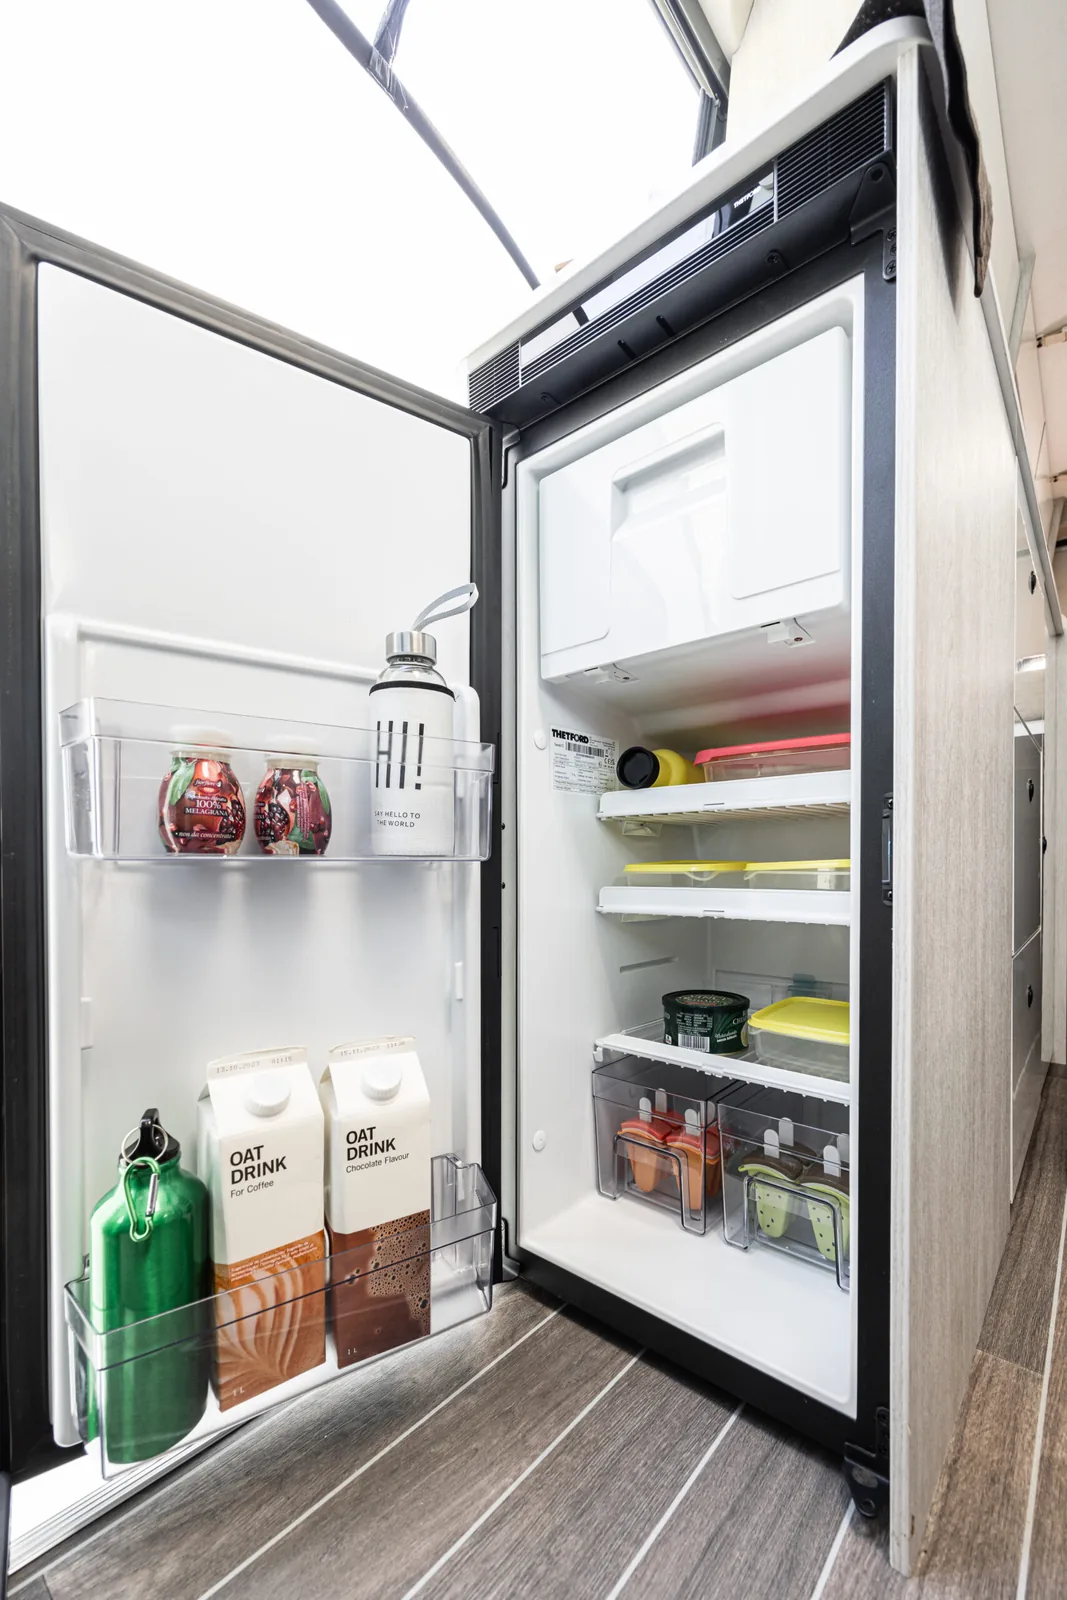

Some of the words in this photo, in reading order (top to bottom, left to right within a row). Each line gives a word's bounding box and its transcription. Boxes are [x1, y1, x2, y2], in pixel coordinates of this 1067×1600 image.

[551, 728, 589, 744] THETFORD
[375, 720, 425, 790] HI!
[185, 807, 228, 817] MELAGRANA
[196, 799, 222, 809] 100%
[346, 1126, 376, 1145] OAT
[230, 1145, 264, 1167] OAT
[346, 1138, 396, 1161] DRINK
[231, 1156, 287, 1185] DRINK
[345, 1159, 382, 1174] Chocolate
[384, 1152, 410, 1165] Flavour
[230, 1188, 245, 1198] For
[246, 1179, 274, 1194] Coffee
